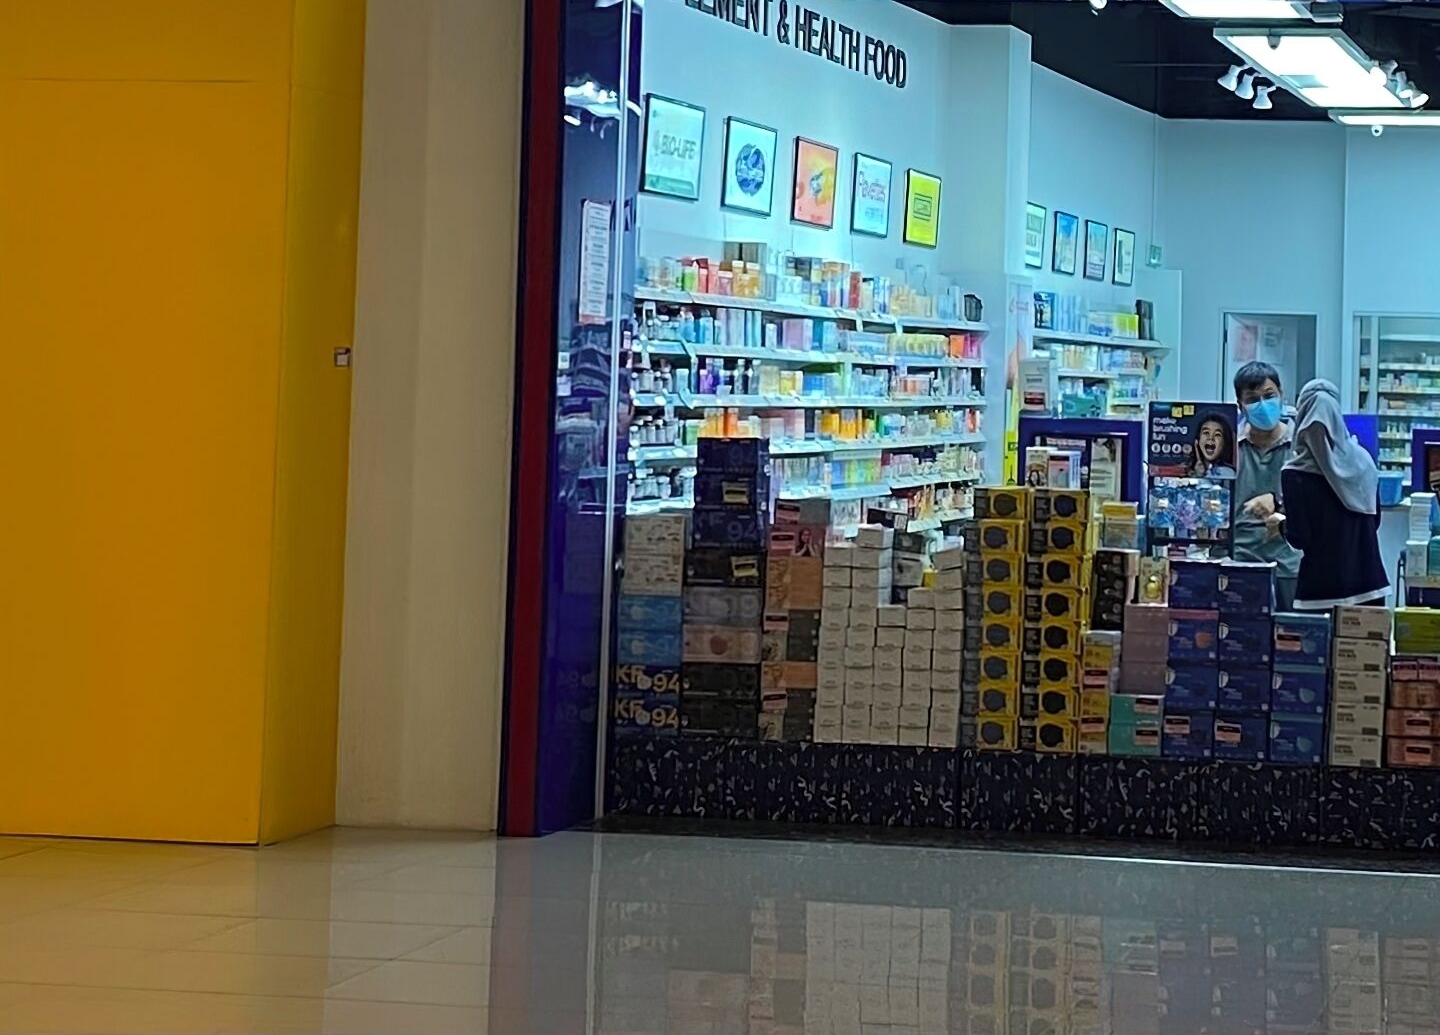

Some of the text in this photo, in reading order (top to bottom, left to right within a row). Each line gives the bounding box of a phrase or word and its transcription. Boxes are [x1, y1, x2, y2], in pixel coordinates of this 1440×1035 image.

[795, 4, 860, 72] HEALTH
[864, 35, 907, 89] FOOD
[653, 673, 680, 694] 94
[651, 707, 679, 729] 94
